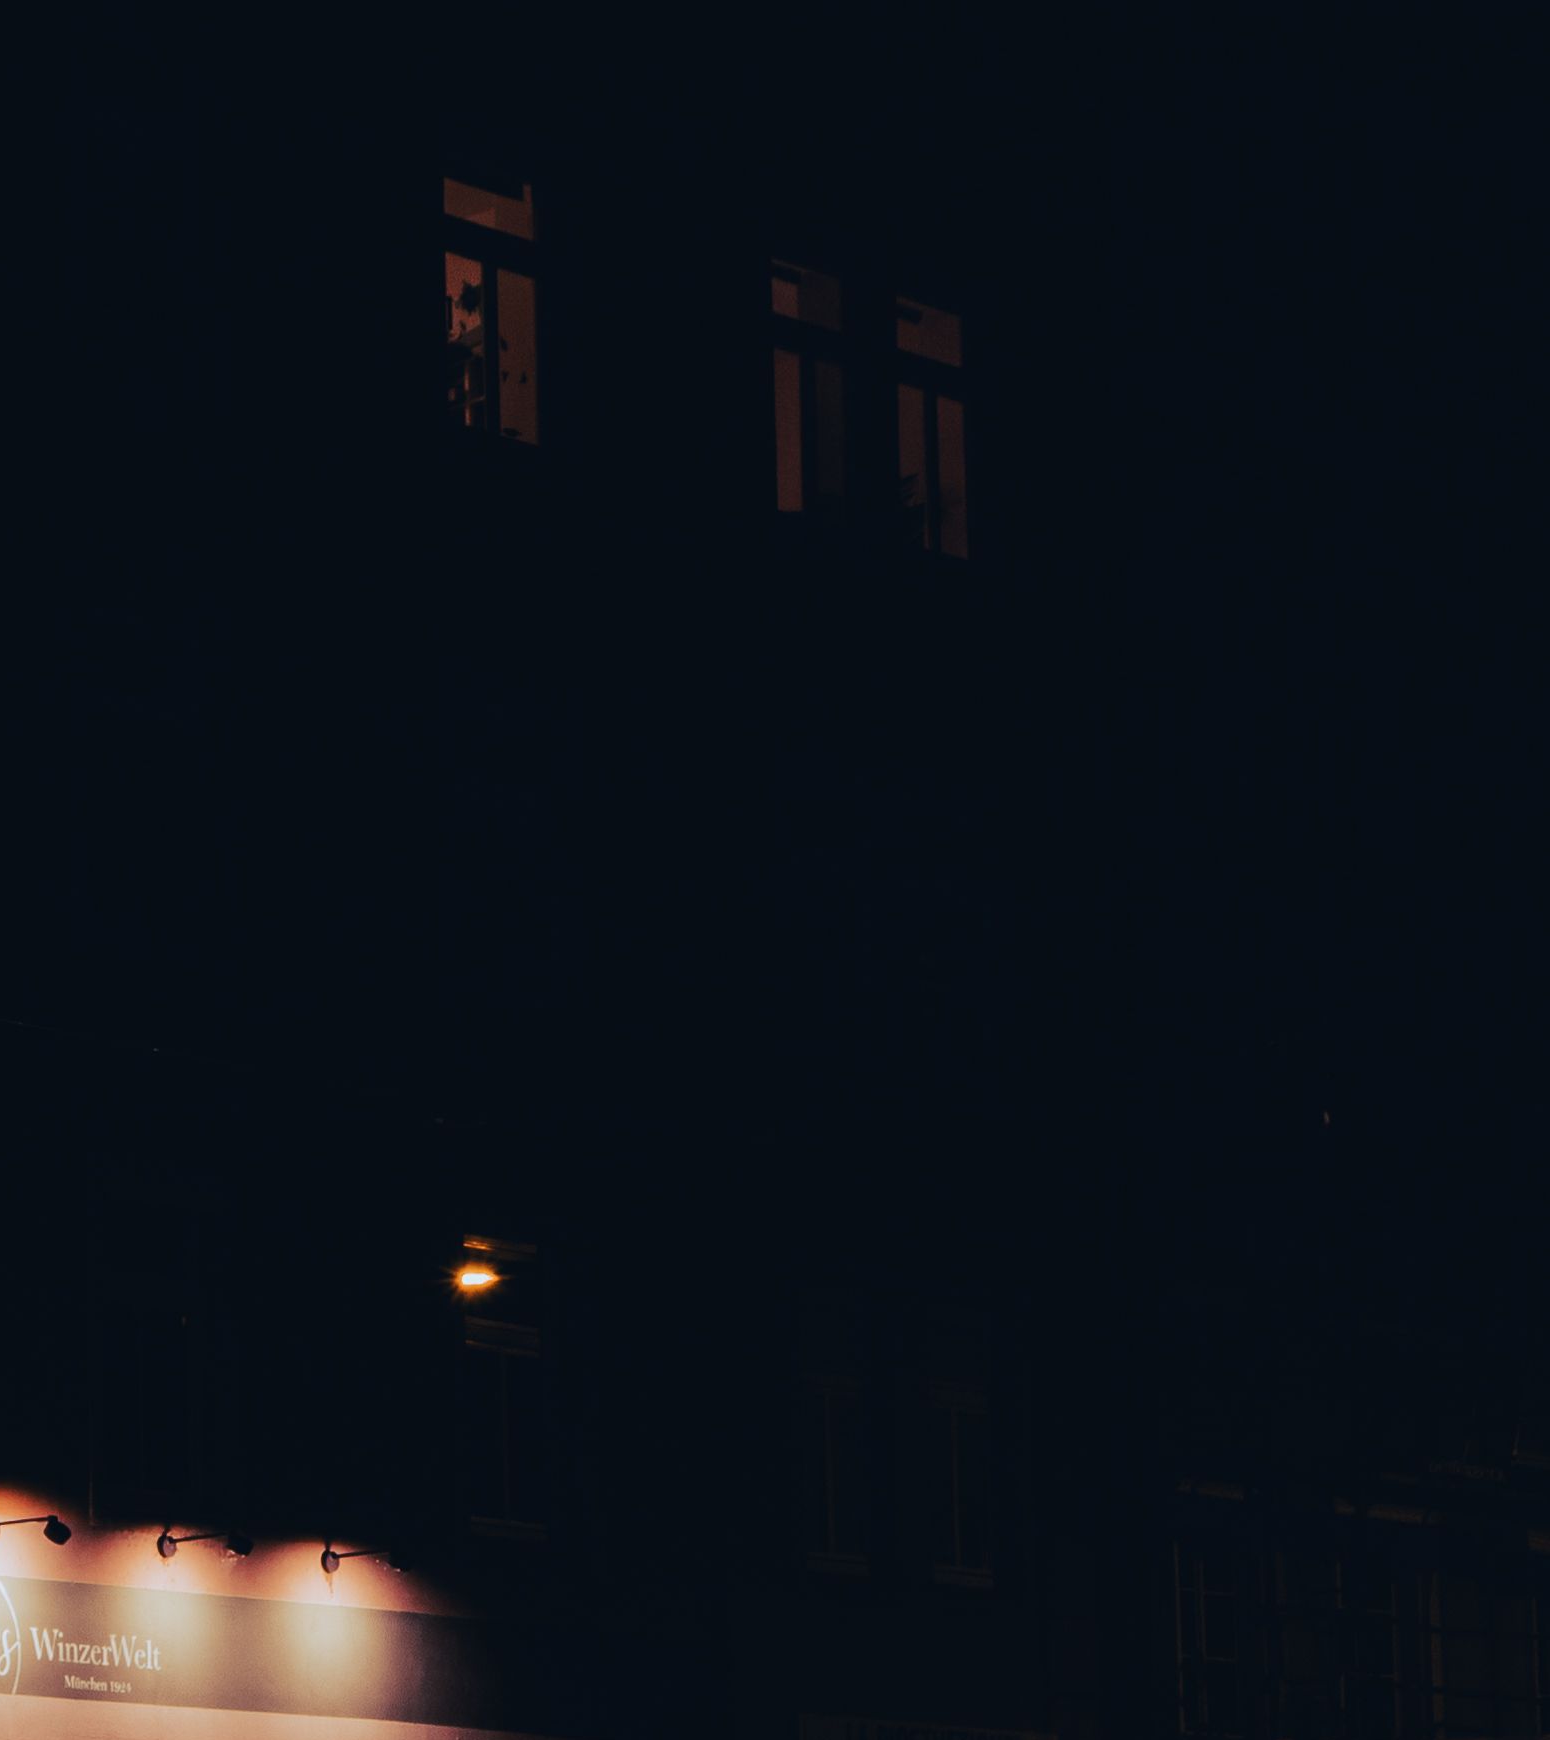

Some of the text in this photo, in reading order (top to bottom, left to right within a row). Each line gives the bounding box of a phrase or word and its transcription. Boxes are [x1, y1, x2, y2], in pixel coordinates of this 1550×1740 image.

[28, 1626, 163, 1672] WinzerWelt
[63, 1674, 132, 1695] München 1924
